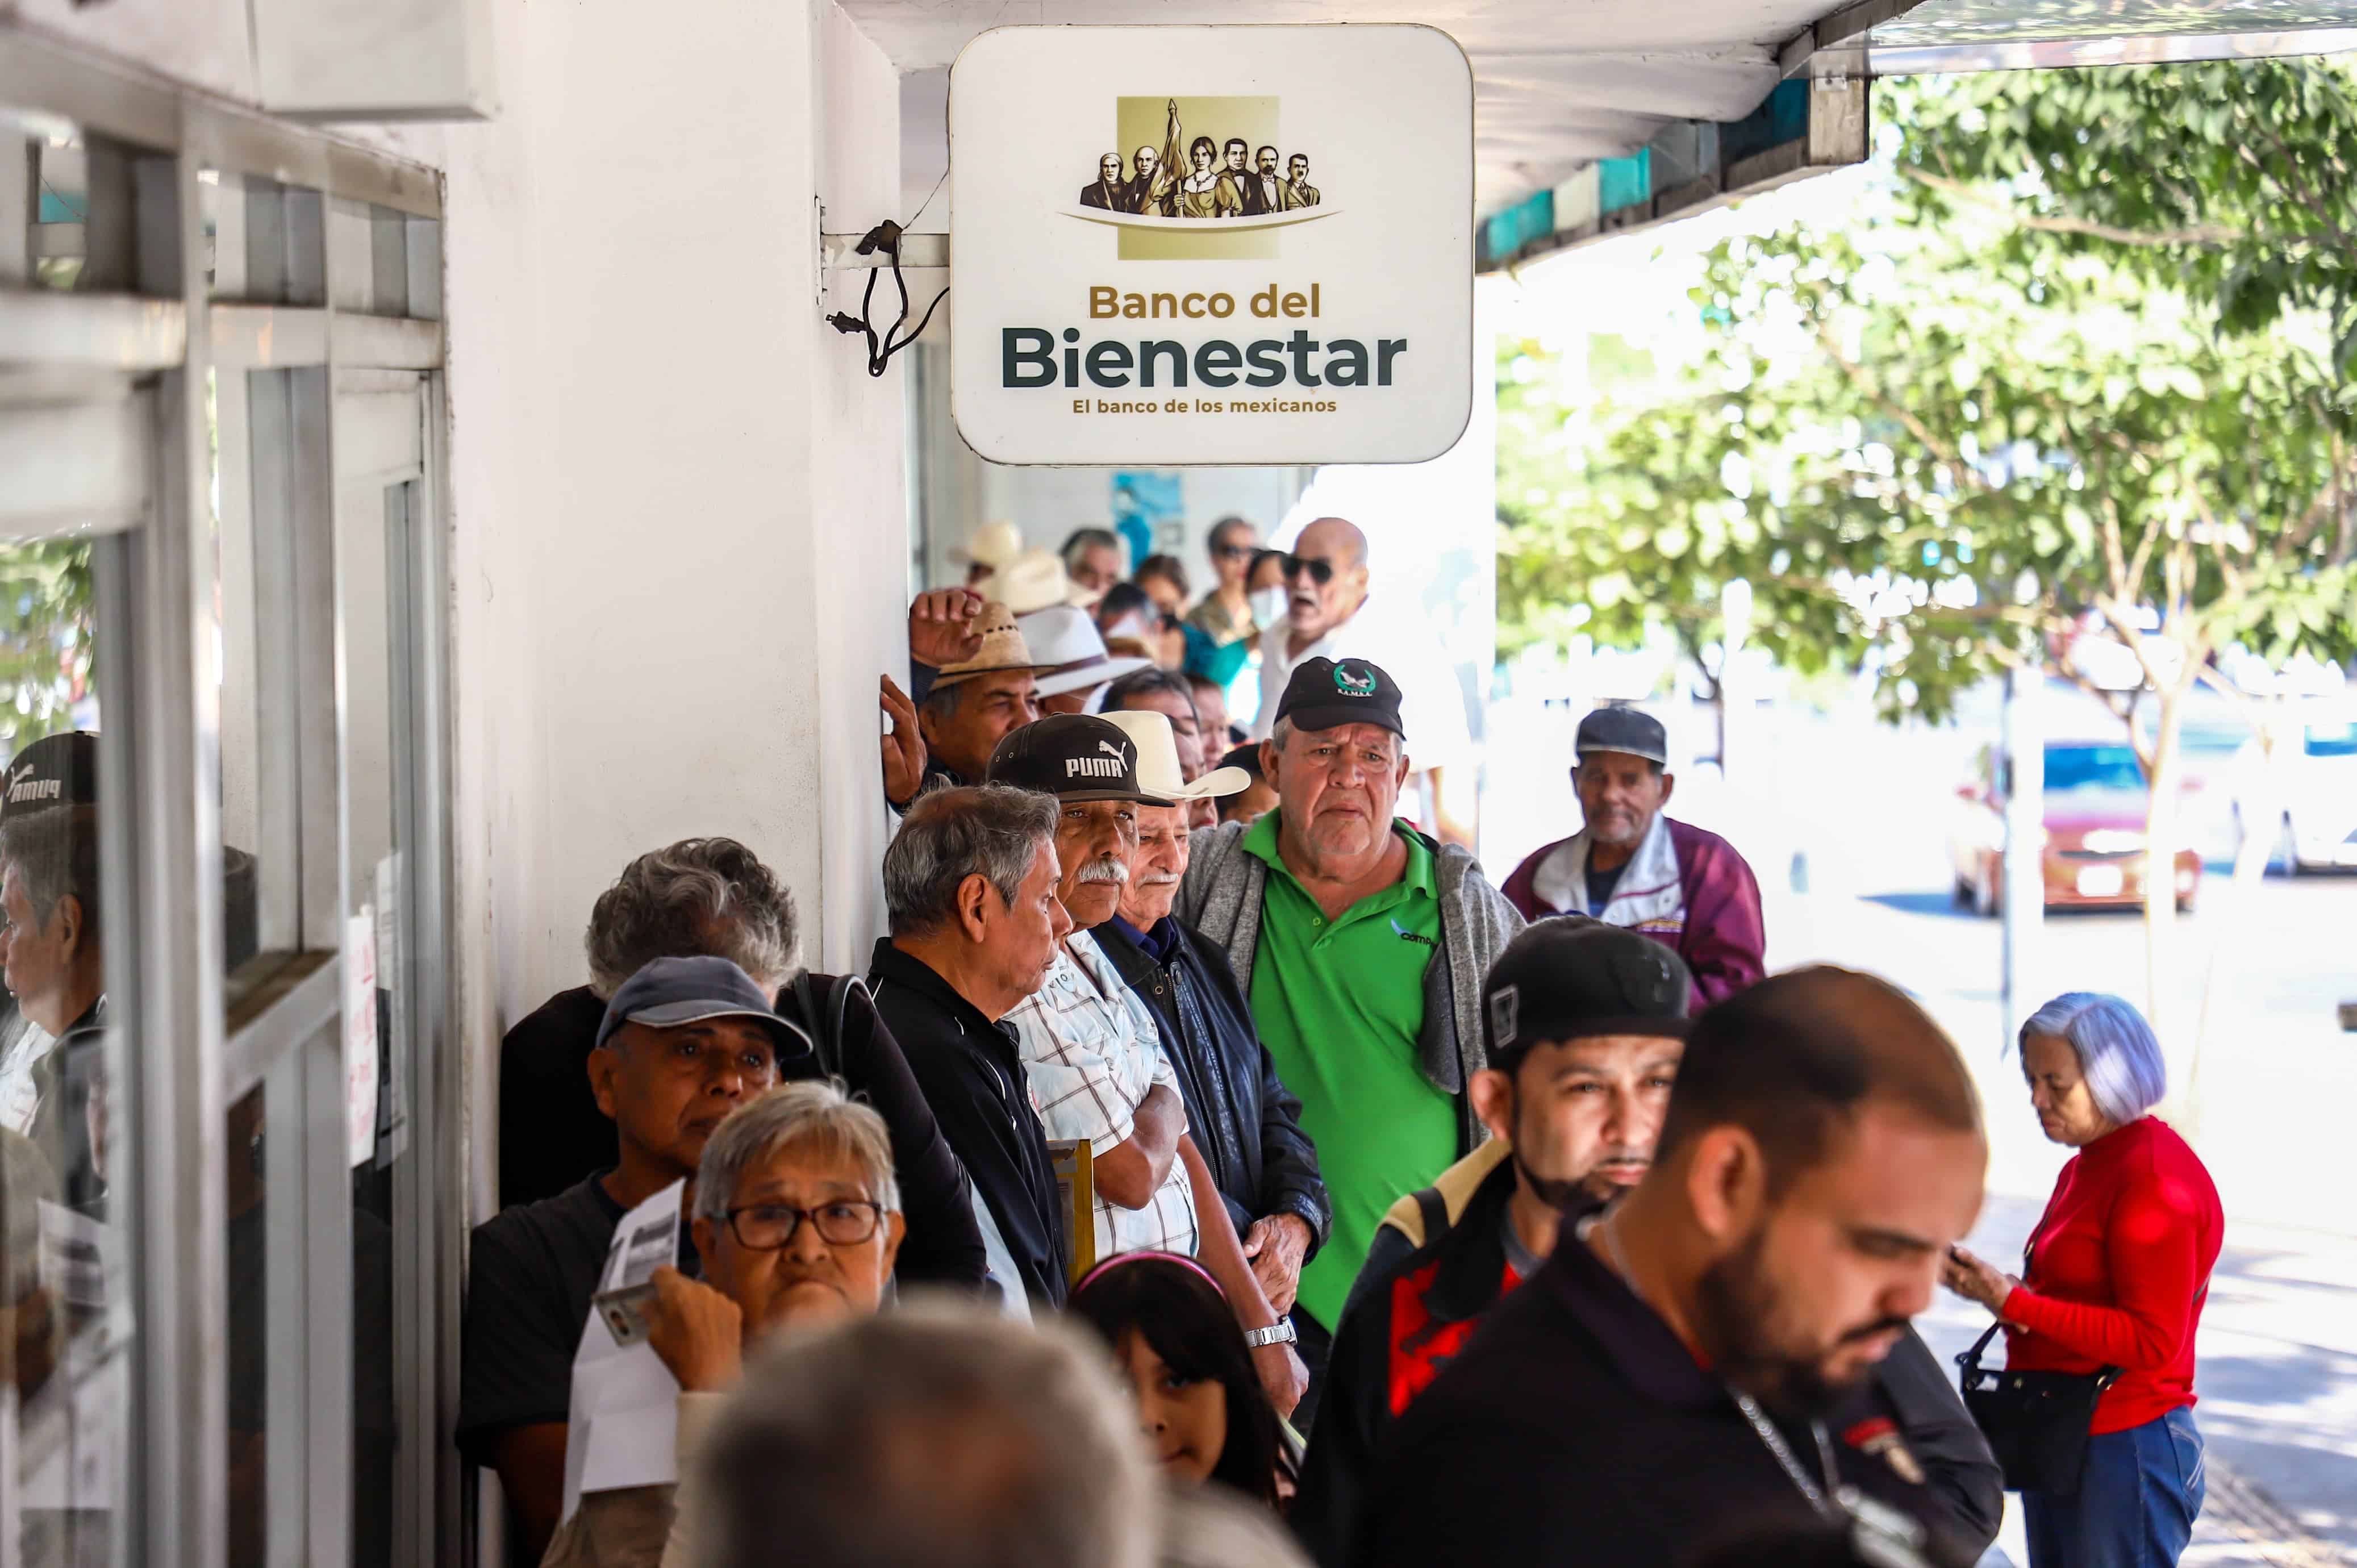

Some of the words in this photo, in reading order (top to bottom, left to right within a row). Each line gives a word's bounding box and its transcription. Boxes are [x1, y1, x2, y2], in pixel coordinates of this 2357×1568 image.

[1089, 286, 1235, 319] Banco
[1250, 283, 1320, 319] del
[1002, 327, 1407, 389] Bienestar
[1073, 399, 1090, 414] El
[1097, 398, 1158, 414] banco
[1164, 398, 1189, 414] de
[1195, 398, 1223, 414] los
[1230, 398, 1337, 414] mexicanos
[1065, 757, 1123, 778] PUMA
